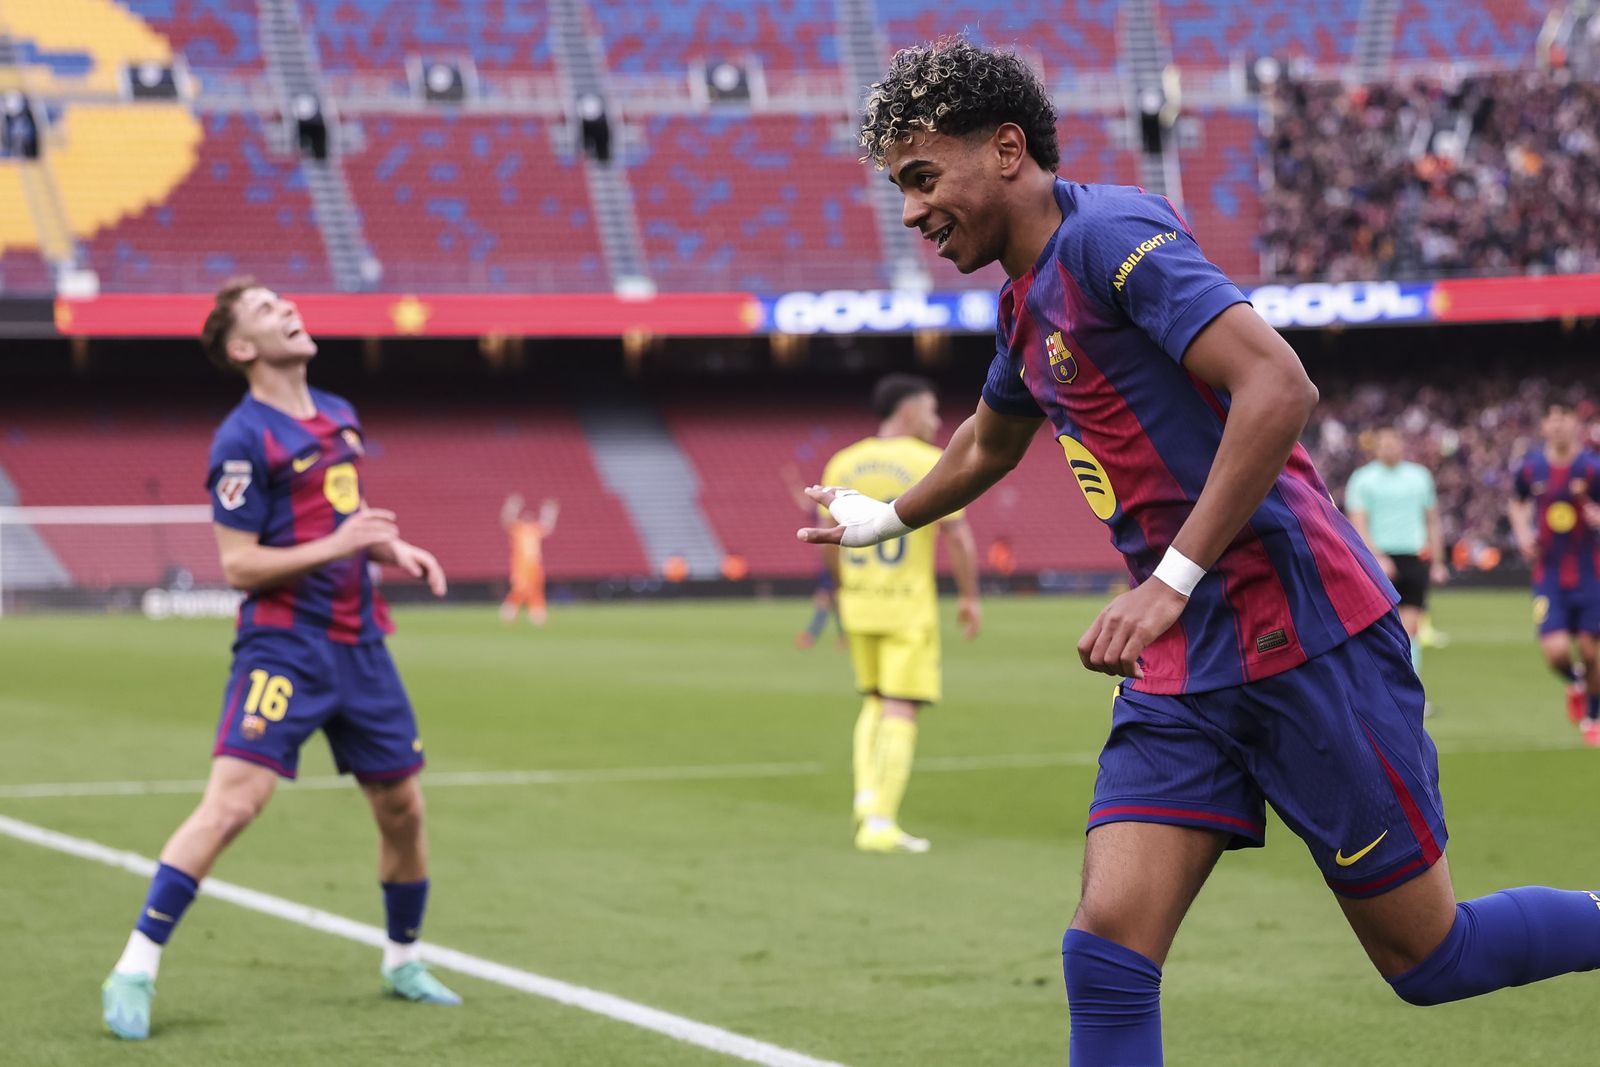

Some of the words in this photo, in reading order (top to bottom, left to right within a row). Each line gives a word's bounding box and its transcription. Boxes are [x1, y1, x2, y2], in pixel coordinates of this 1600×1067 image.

[1112, 234, 1166, 292] AMBILIGHT
[774, 290, 949, 334] GOUL
[243, 668, 294, 722] 16
